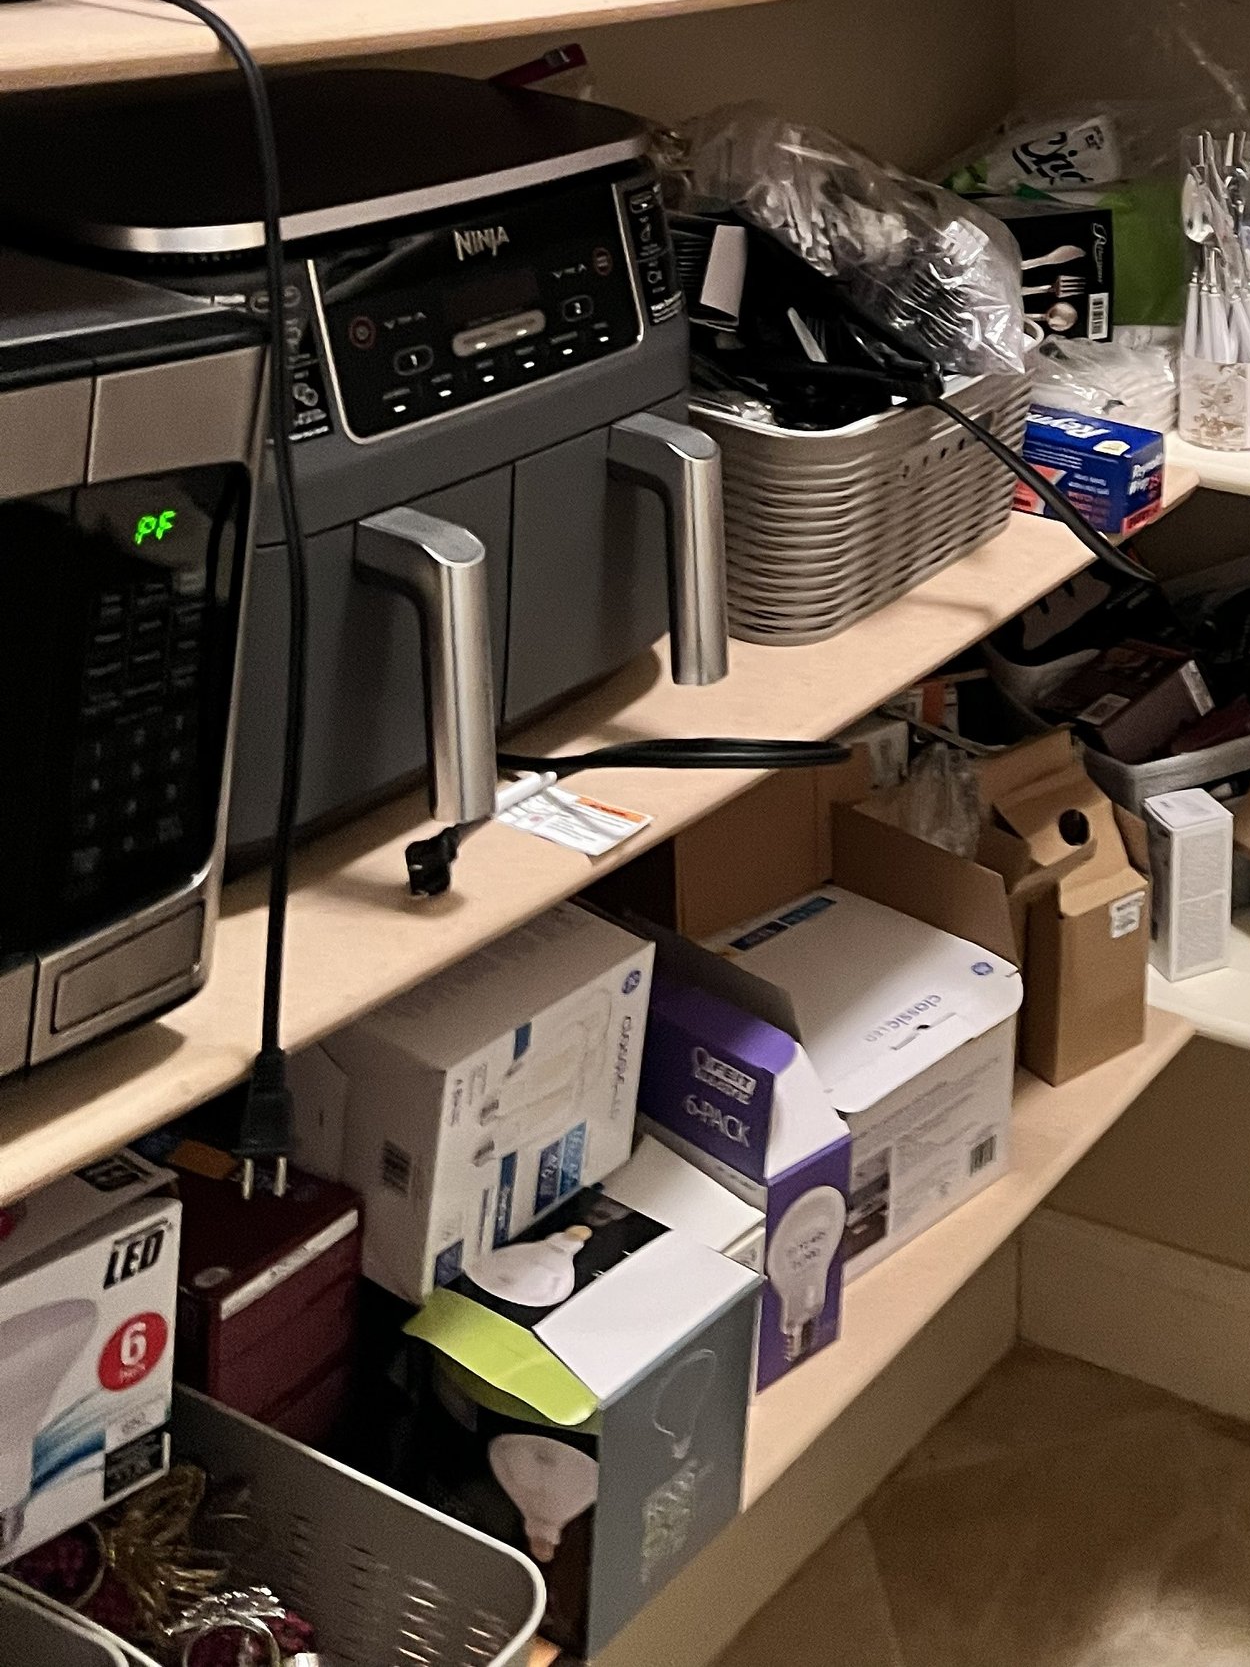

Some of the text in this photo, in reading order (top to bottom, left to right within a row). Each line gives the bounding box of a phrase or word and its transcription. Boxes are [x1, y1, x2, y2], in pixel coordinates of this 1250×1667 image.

[451, 225, 511, 261] NINJA
[684, 1094, 750, 1148] 6-PACK
[104, 1228, 165, 1289] LED
[120, 1321, 147, 1367] 6
